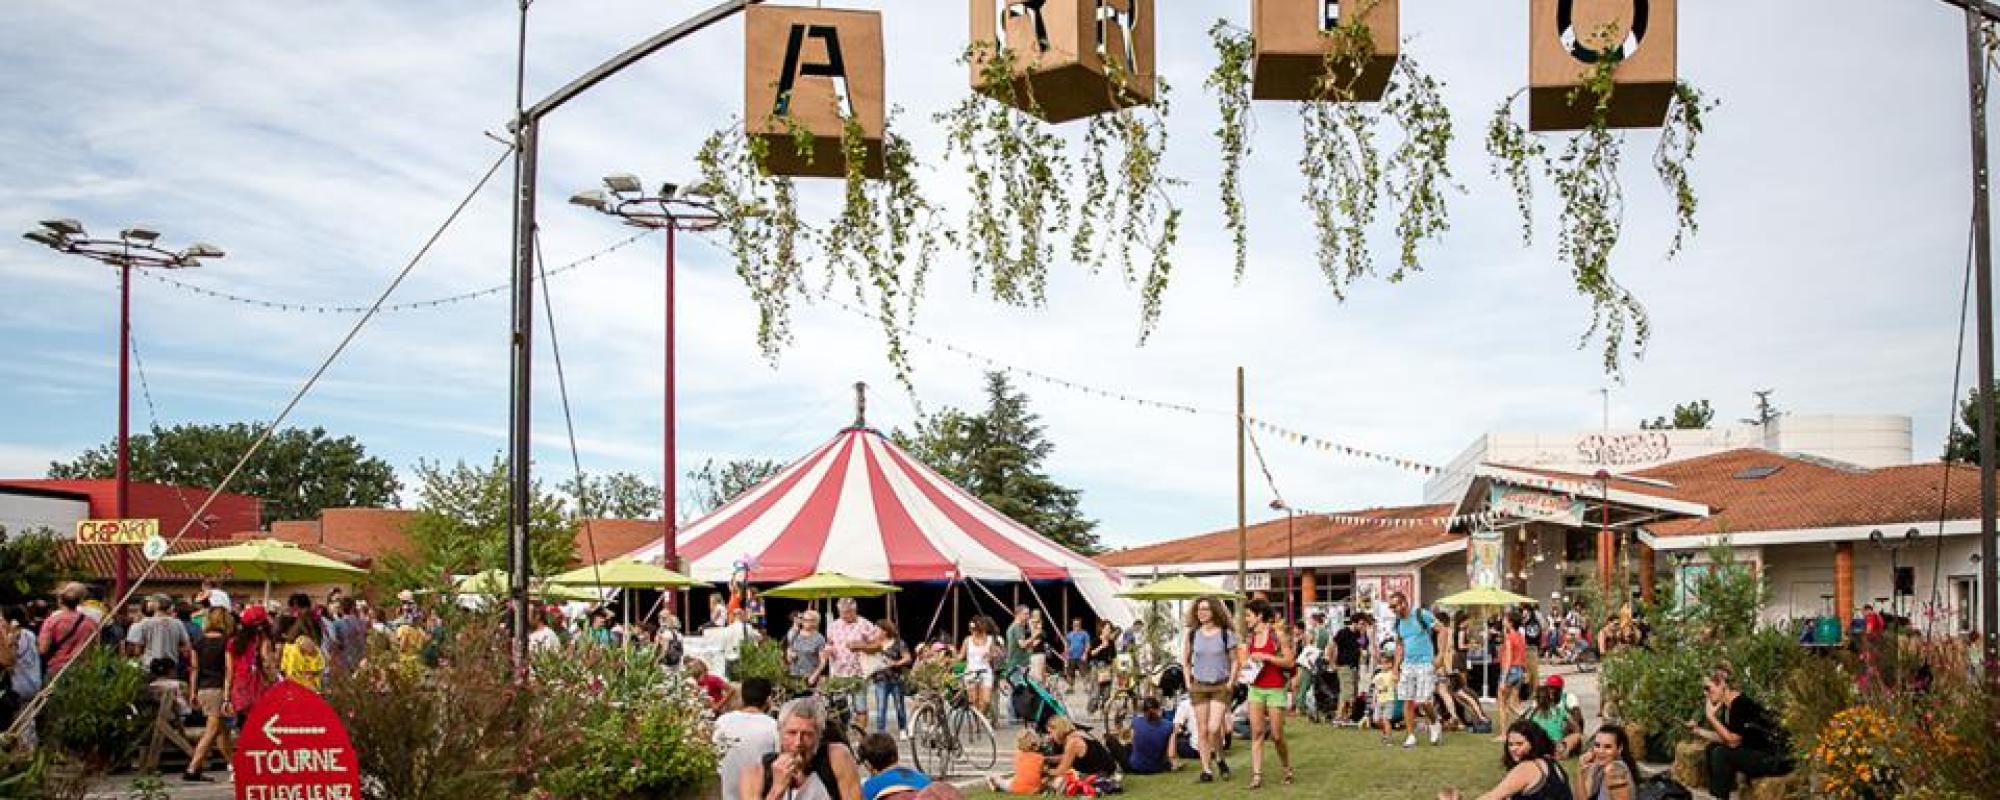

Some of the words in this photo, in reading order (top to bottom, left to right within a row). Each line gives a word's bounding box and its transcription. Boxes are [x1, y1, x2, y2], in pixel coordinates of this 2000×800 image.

[772, 22, 853, 118] A
[245, 748, 348, 775] TOURNE
[245, 783, 268, 800] ET
[270, 783, 303, 800] LEVE
[305, 783, 323, 800] LE
[326, 783, 353, 800] NEZ
